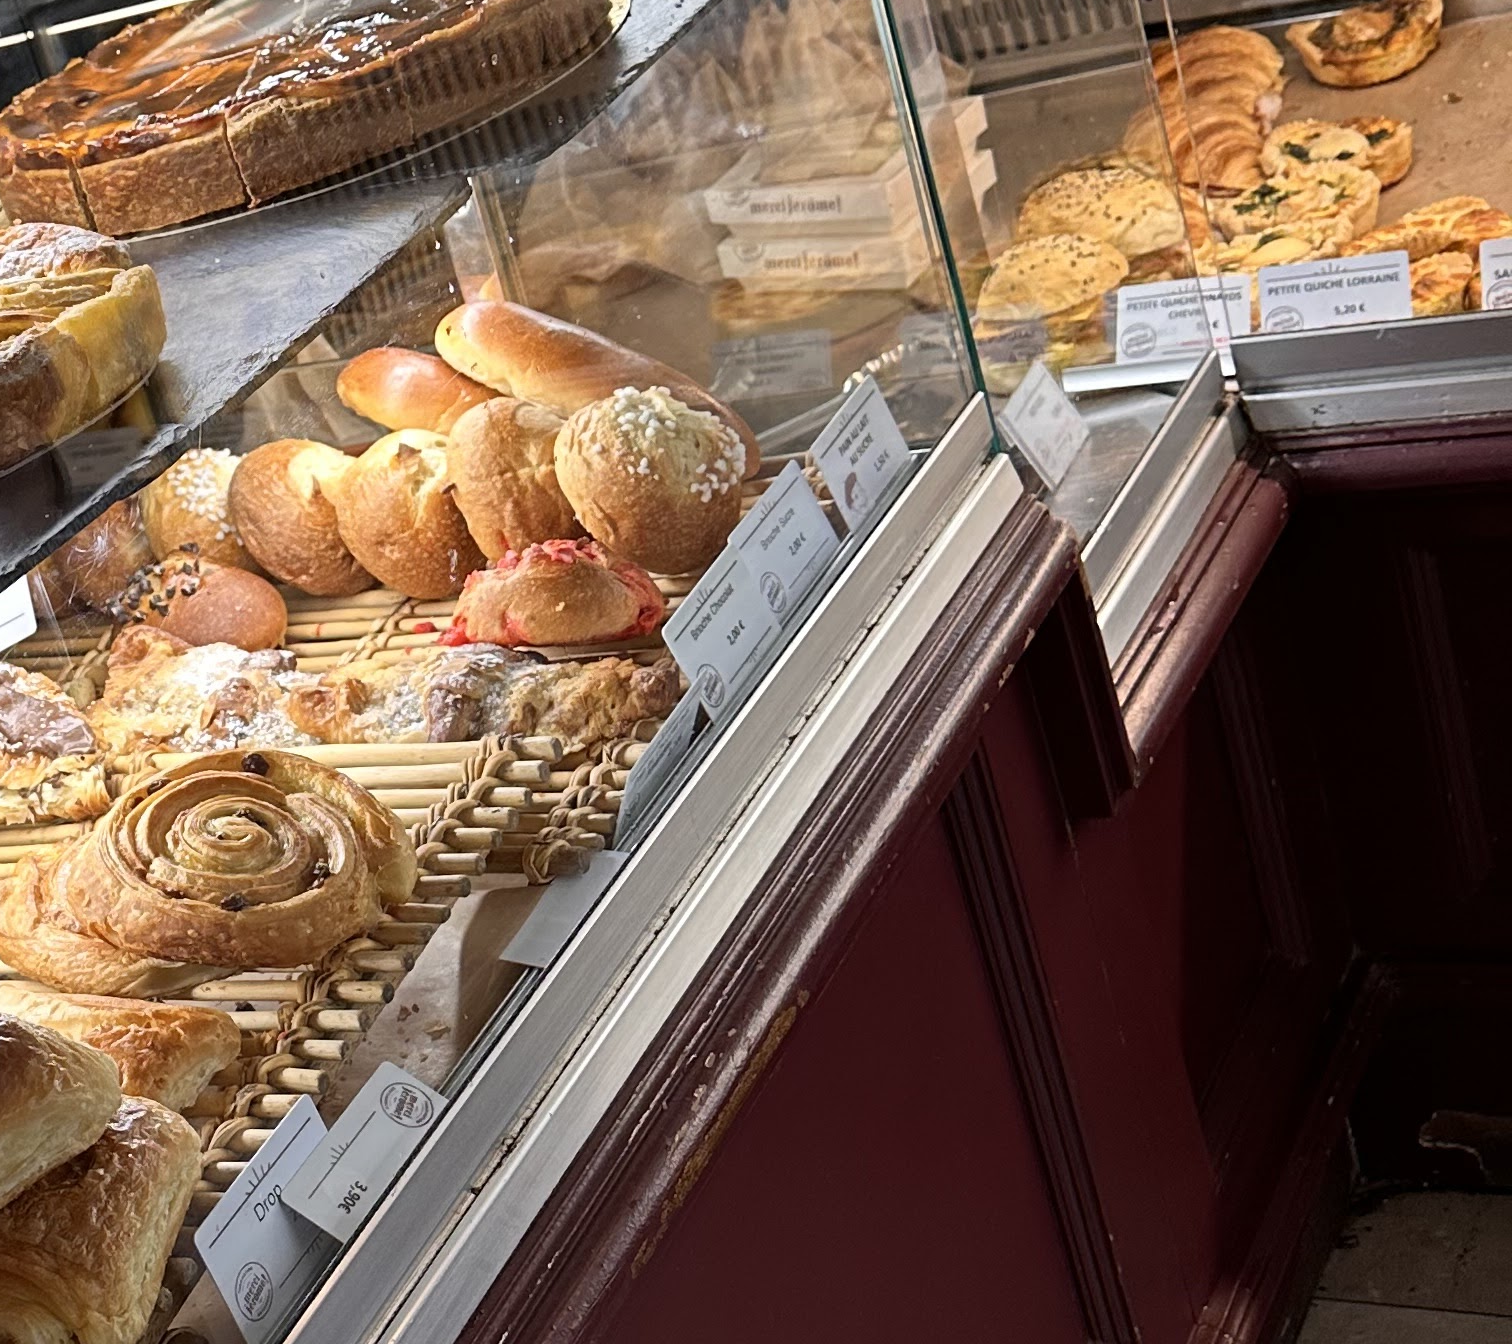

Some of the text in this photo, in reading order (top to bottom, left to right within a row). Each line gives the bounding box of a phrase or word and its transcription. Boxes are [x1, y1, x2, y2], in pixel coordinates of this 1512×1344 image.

[1267, 271, 1400, 296] PETITE QUICHE LORRAINE
[760, 523, 781, 551] Brioche
[690, 583, 735, 641] Brioche Chocolat
[726, 625, 741, 646] 2,00
[338, 1181, 368, 1214] 3,90€
